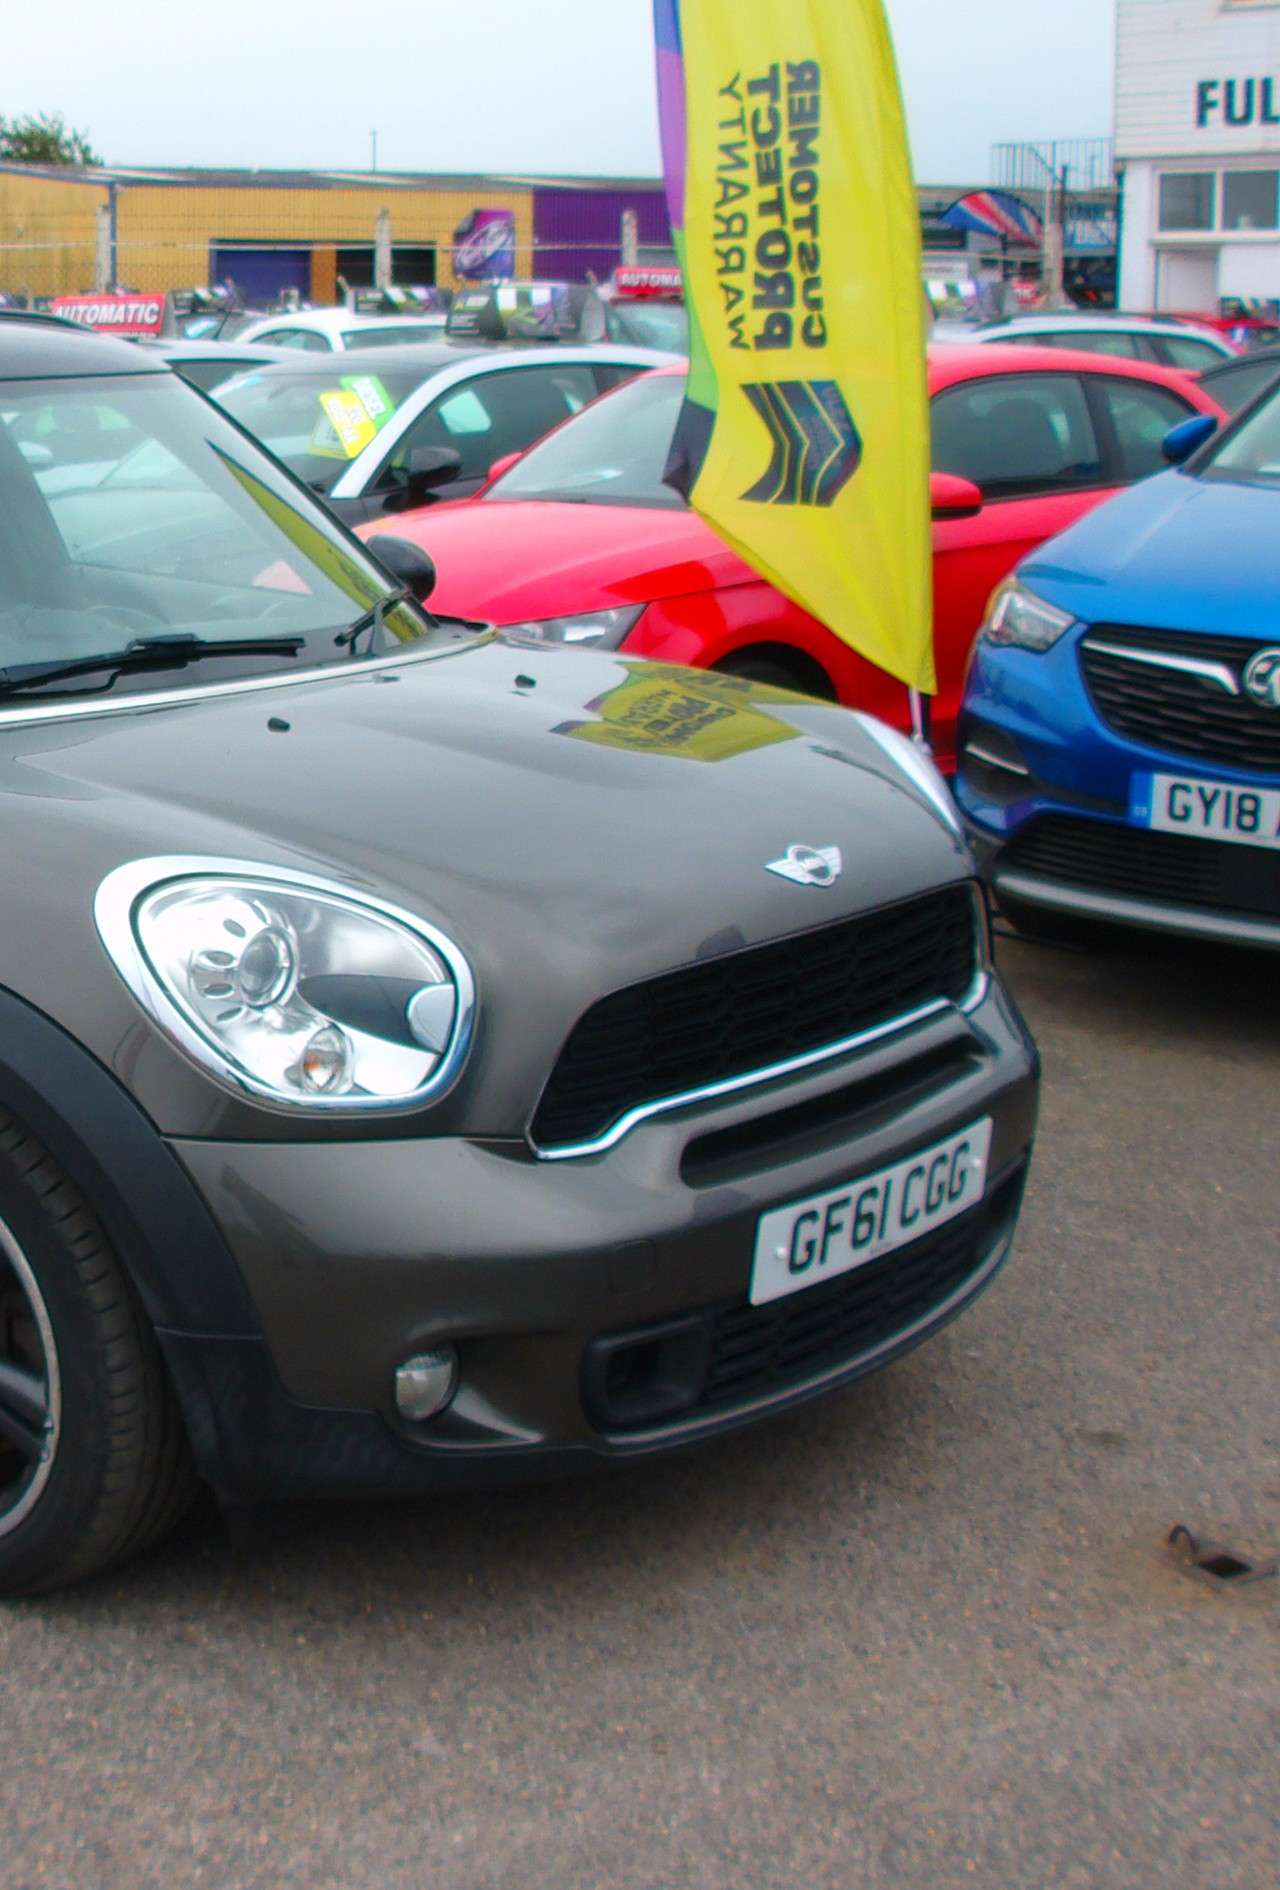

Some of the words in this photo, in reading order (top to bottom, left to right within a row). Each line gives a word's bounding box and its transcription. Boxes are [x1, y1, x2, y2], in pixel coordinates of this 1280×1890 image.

[622, 272, 682, 287] AUTOMA
[55, 301, 160, 325] AUTOMATIC
[1168, 782, 1262, 833] GY18
[787, 1178, 893, 1276] GF61
[899, 1140, 970, 1229] CGG
